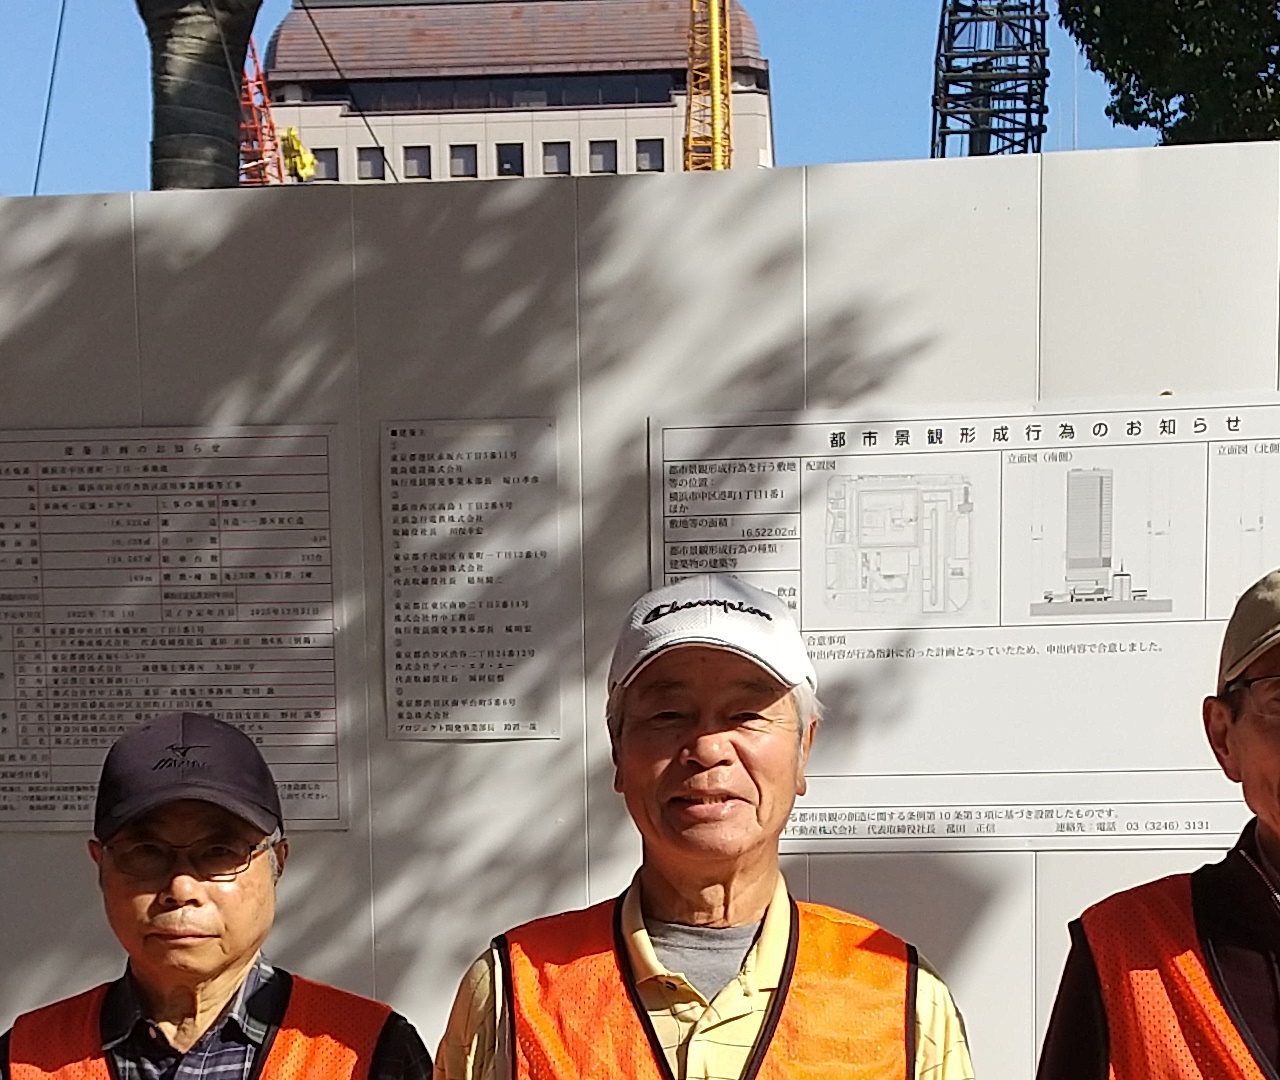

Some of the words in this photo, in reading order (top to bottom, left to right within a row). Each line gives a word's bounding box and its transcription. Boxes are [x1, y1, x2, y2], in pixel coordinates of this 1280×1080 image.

[829, 414, 1244, 449] 都市景観形成行為のお知らせ
[669, 461, 796, 475] 都市景観形成行為を行う敷地
[805, 459, 836, 472] 配置図
[669, 503, 689, 514] ほか
[642, 600, 772, 624] Champion
[807, 634, 847, 647] 合意事項
